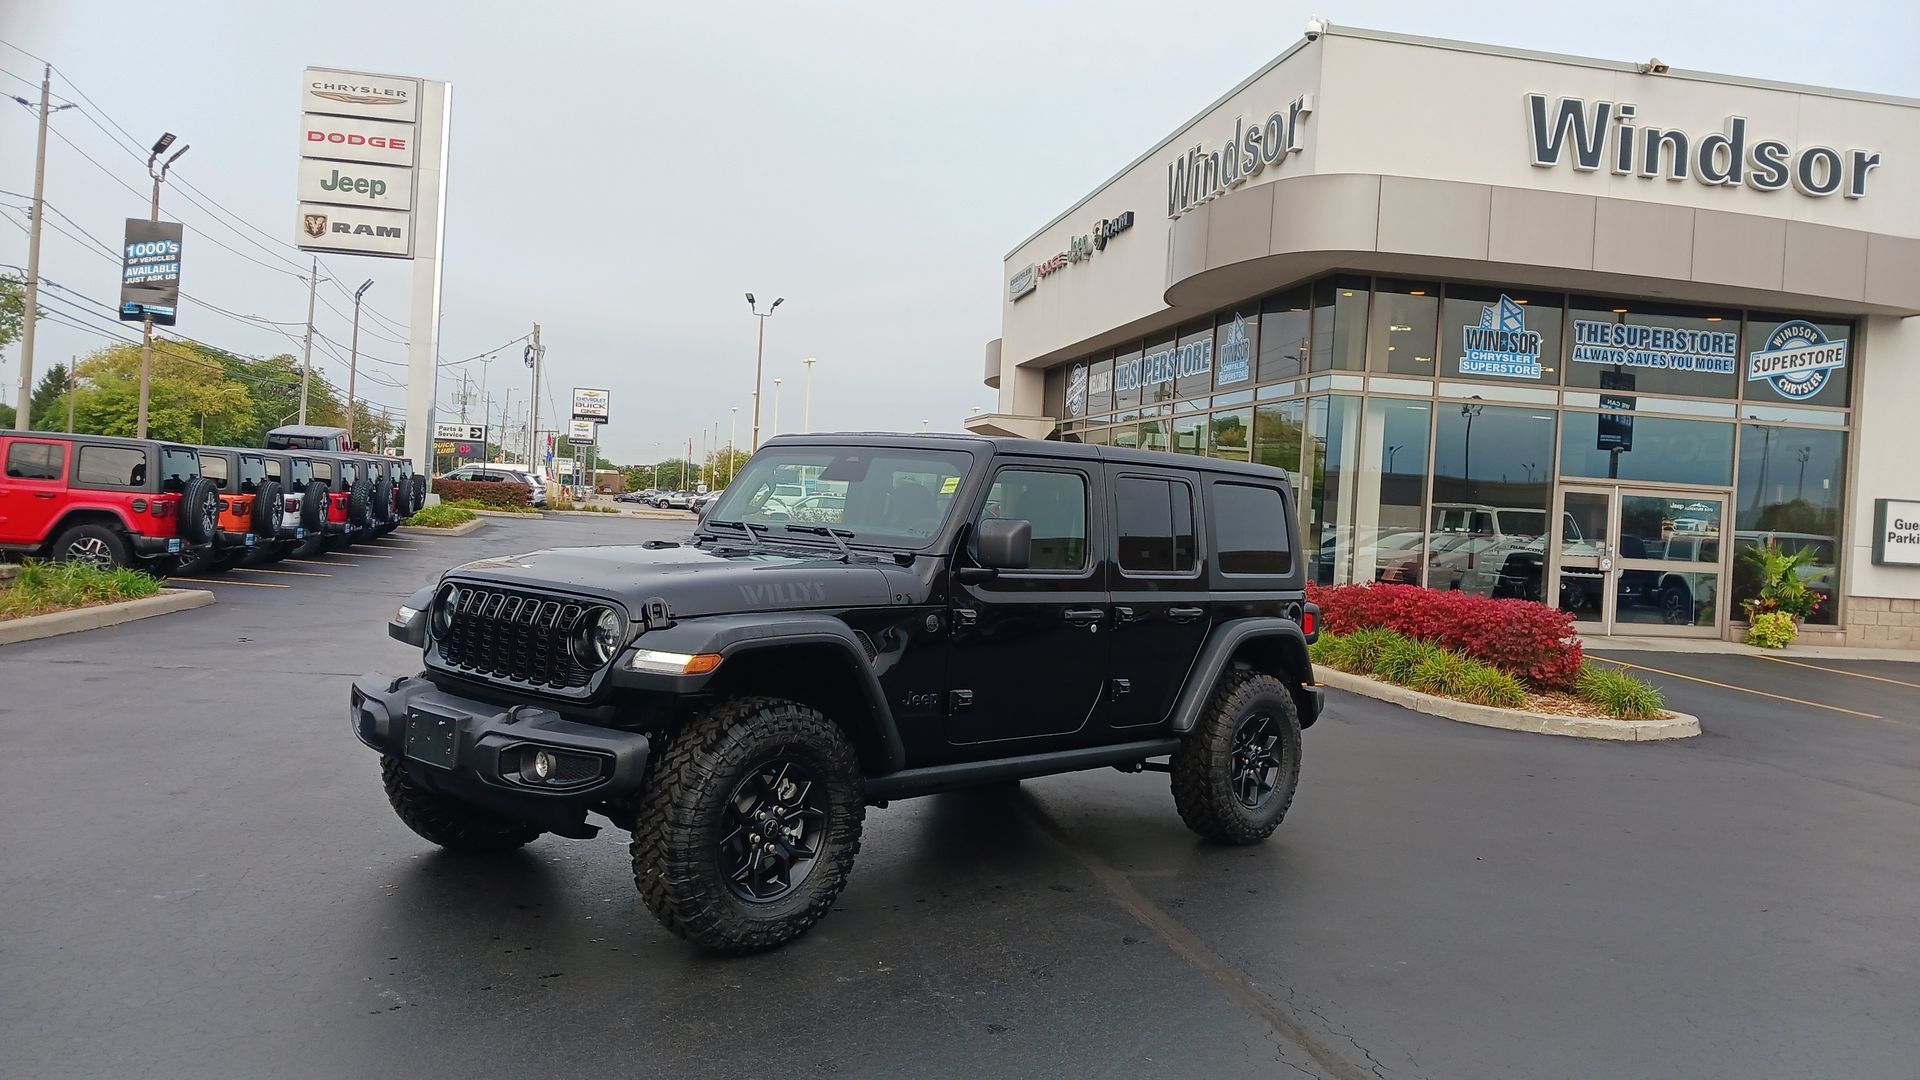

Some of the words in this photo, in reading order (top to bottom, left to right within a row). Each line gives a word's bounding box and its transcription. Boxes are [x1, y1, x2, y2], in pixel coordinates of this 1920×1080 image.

[311, 82, 407, 98] CHRYSLER
[307, 130, 406, 150] DODGE
[1525, 92, 1882, 199] Windsor
[1167, 94, 1312, 220] Windsor
[320, 169, 387, 199] Jeep
[332, 221, 401, 239] RAM
[1103, 211, 1133, 238] RAM
[127, 242, 179, 257] 1000's
[139, 254, 176, 263] VEHICLES
[126, 264, 177, 276] AVAILABLE
[1466, 329, 1539, 355] WINDSOR
[1576, 322, 1610, 343] THE
[1613, 324, 1736, 354] SUPERSTORE
[1773, 326, 1818, 347] WINDSOR
[1115, 366, 1128, 391] THE
[1130, 338, 1212, 390] SUPERSTORE
[1463, 361, 1539, 375] SUPERSTORE
[1471, 351, 1531, 364] CHRYSLER
[1575, 347, 1624, 363] ALWAYS
[1627, 350, 1666, 366] SAVES
[1670, 354, 1693, 368] YOU
[1695, 356, 1734, 372] MORE!
[1753, 348, 1843, 373] SUPERSTORE
[1778, 372, 1824, 395] CHRYSLER
[1894, 518, 1920, 531] Gue
[1888, 531, 1920, 544] Parki
[737, 581, 826, 605] WILLYS
[902, 690, 939, 708] Jeep
